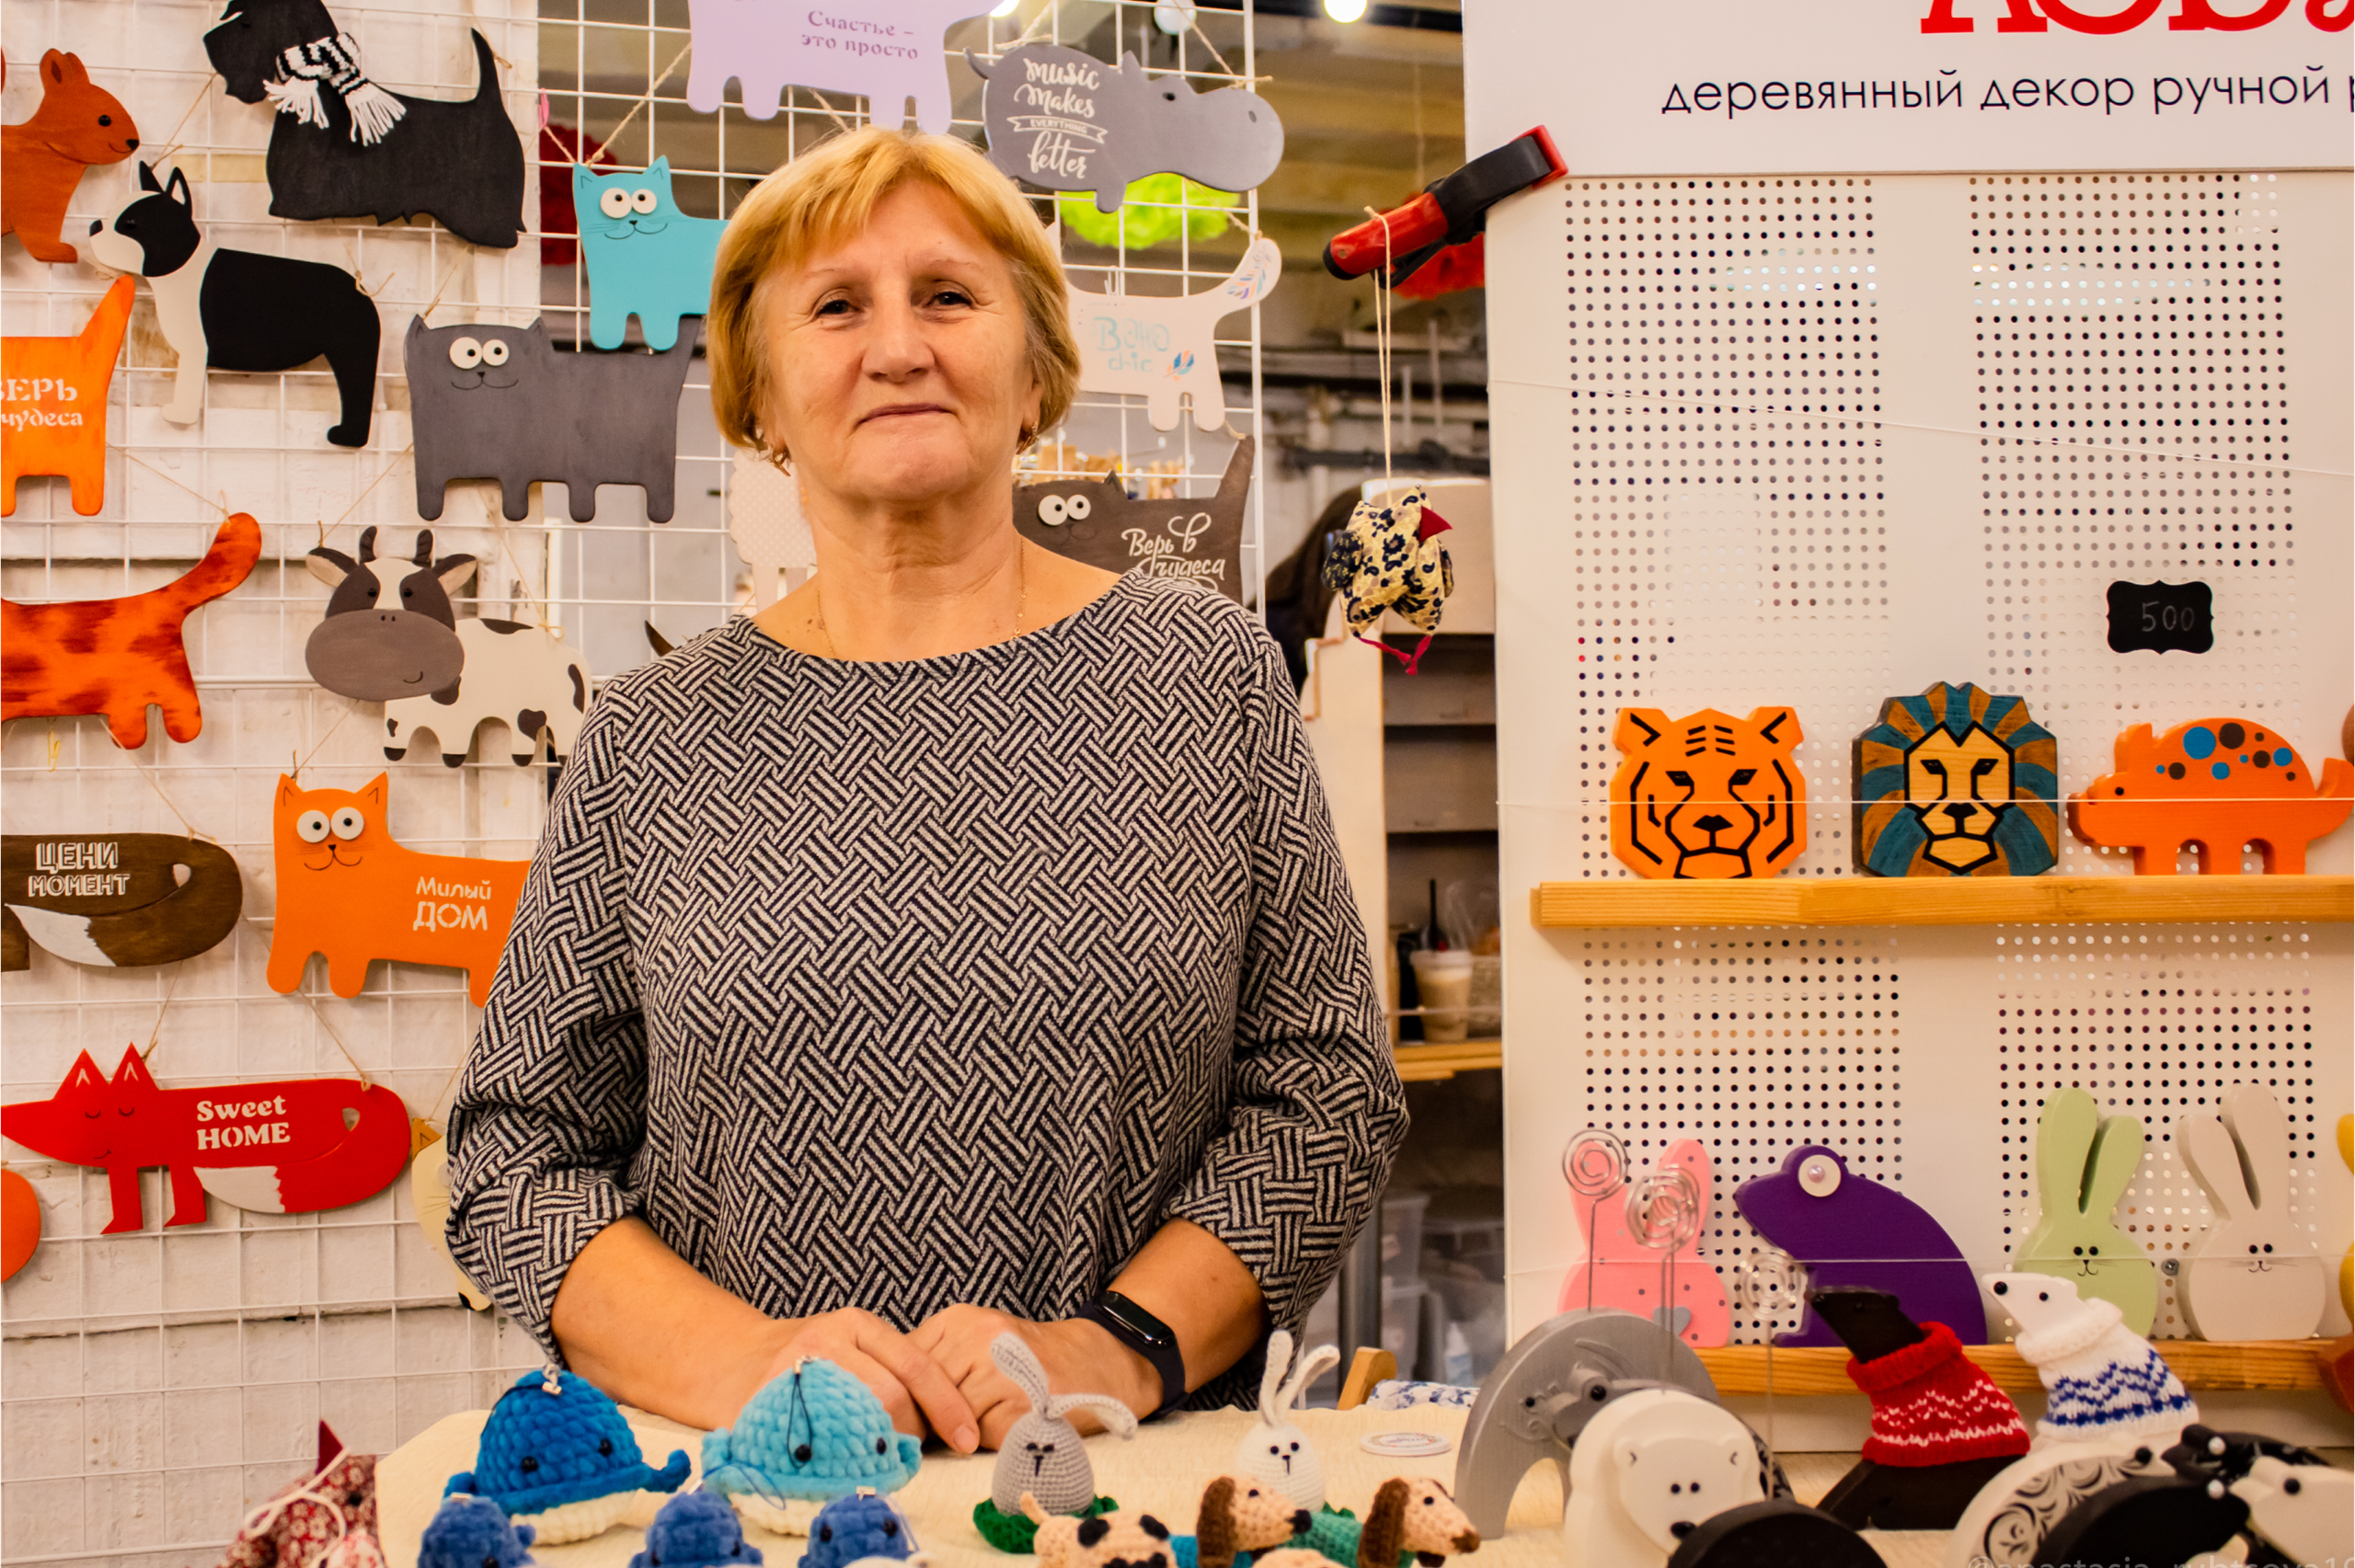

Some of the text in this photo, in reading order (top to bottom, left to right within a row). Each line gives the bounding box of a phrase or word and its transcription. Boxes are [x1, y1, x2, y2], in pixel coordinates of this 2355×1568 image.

[808, 10, 896, 37] Счастье
[801, 33, 918, 60] это просто
[1661, 69, 1962, 120] деревянный
[1980, 77, 2134, 115] декор
[2154, 65, 2329, 115] ручной
[1030, 119, 1087, 134] EVERYTHING
[0, 378, 77, 402] ЕРЬ
[1120, 528, 1175, 578] Верь
[2142, 601, 2195, 633] 500
[36, 841, 119, 875] ЦЕНИ
[28, 873, 131, 898] МОМЕНТ
[416, 876, 491, 900] Милый
[413, 900, 488, 933] ДОМ
[196, 1094, 287, 1122] Sweet
[196, 1121, 291, 1150] HOME
